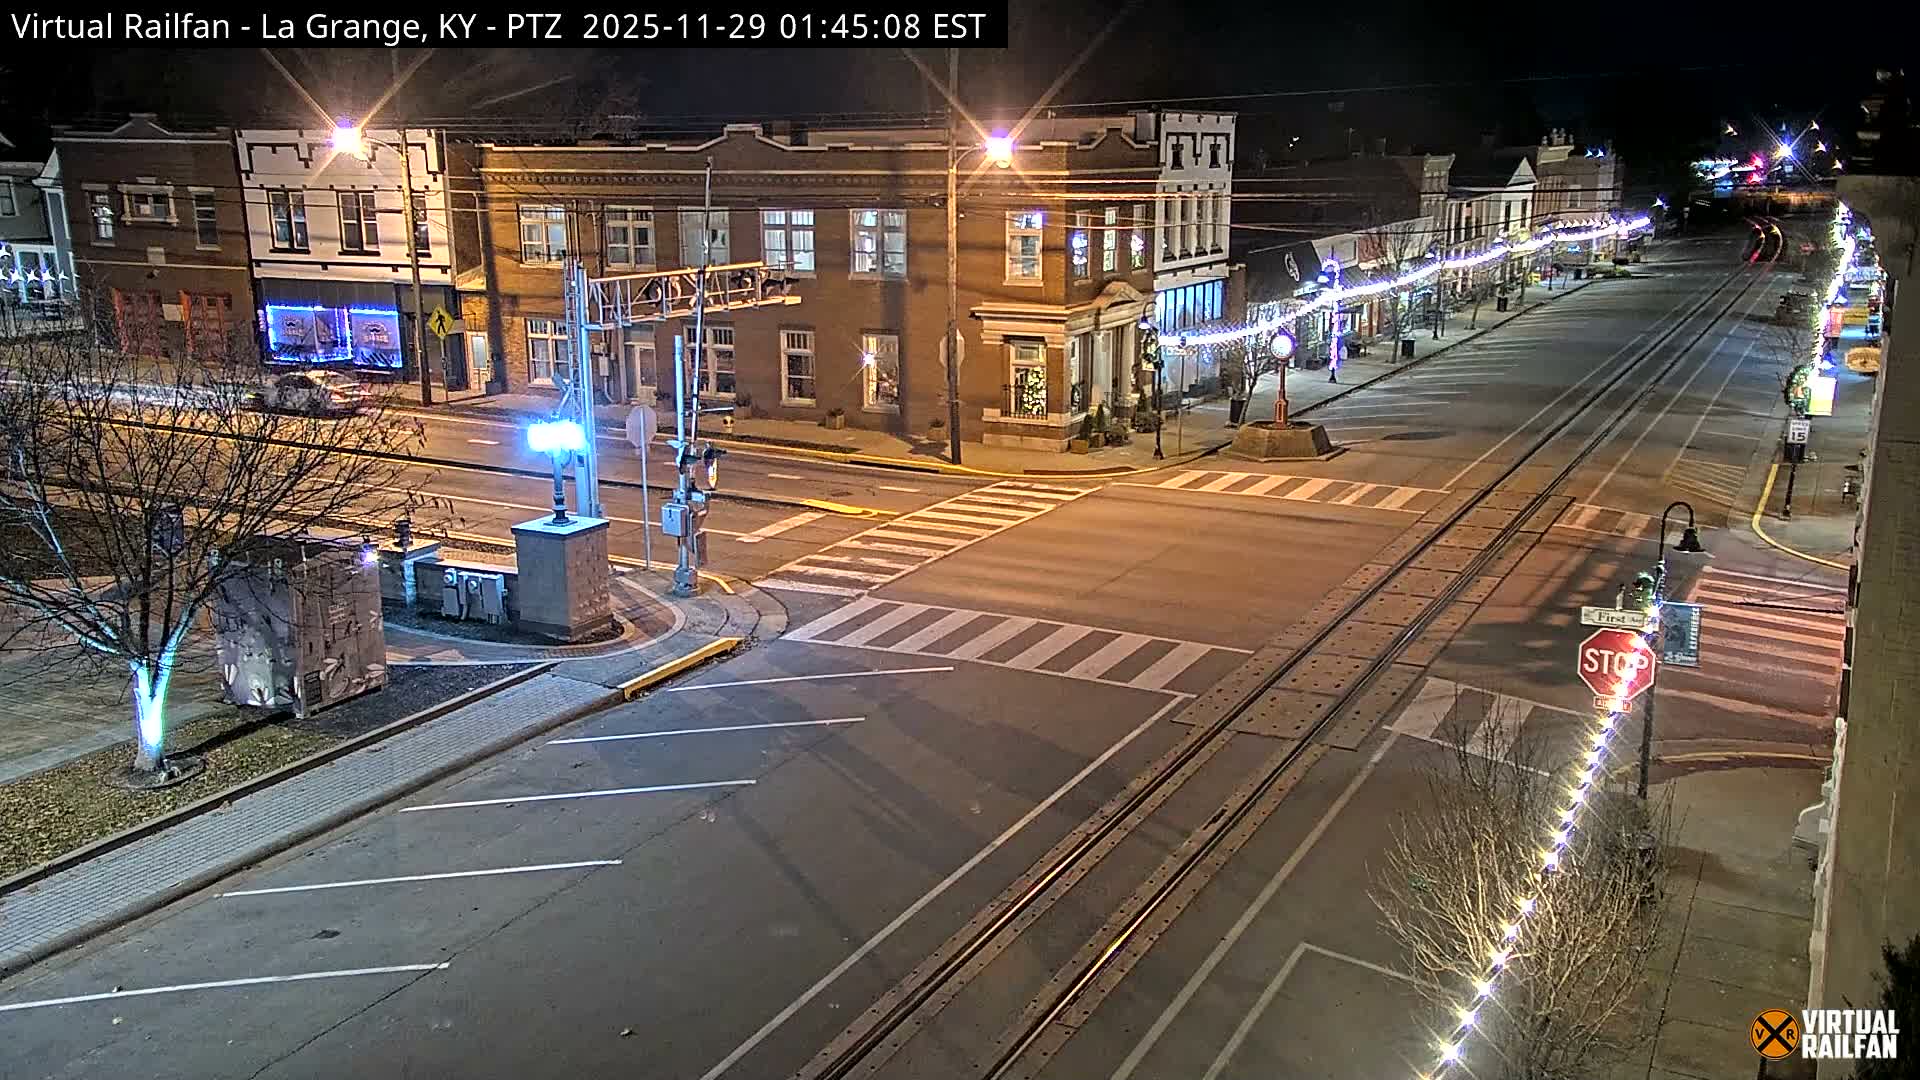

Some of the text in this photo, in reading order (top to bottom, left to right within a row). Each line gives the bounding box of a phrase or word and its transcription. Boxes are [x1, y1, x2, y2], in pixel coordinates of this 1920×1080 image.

[1791, 432, 1806, 441] 15
[1598, 611, 1625, 624] First
[1583, 648, 1649, 677] STOP
